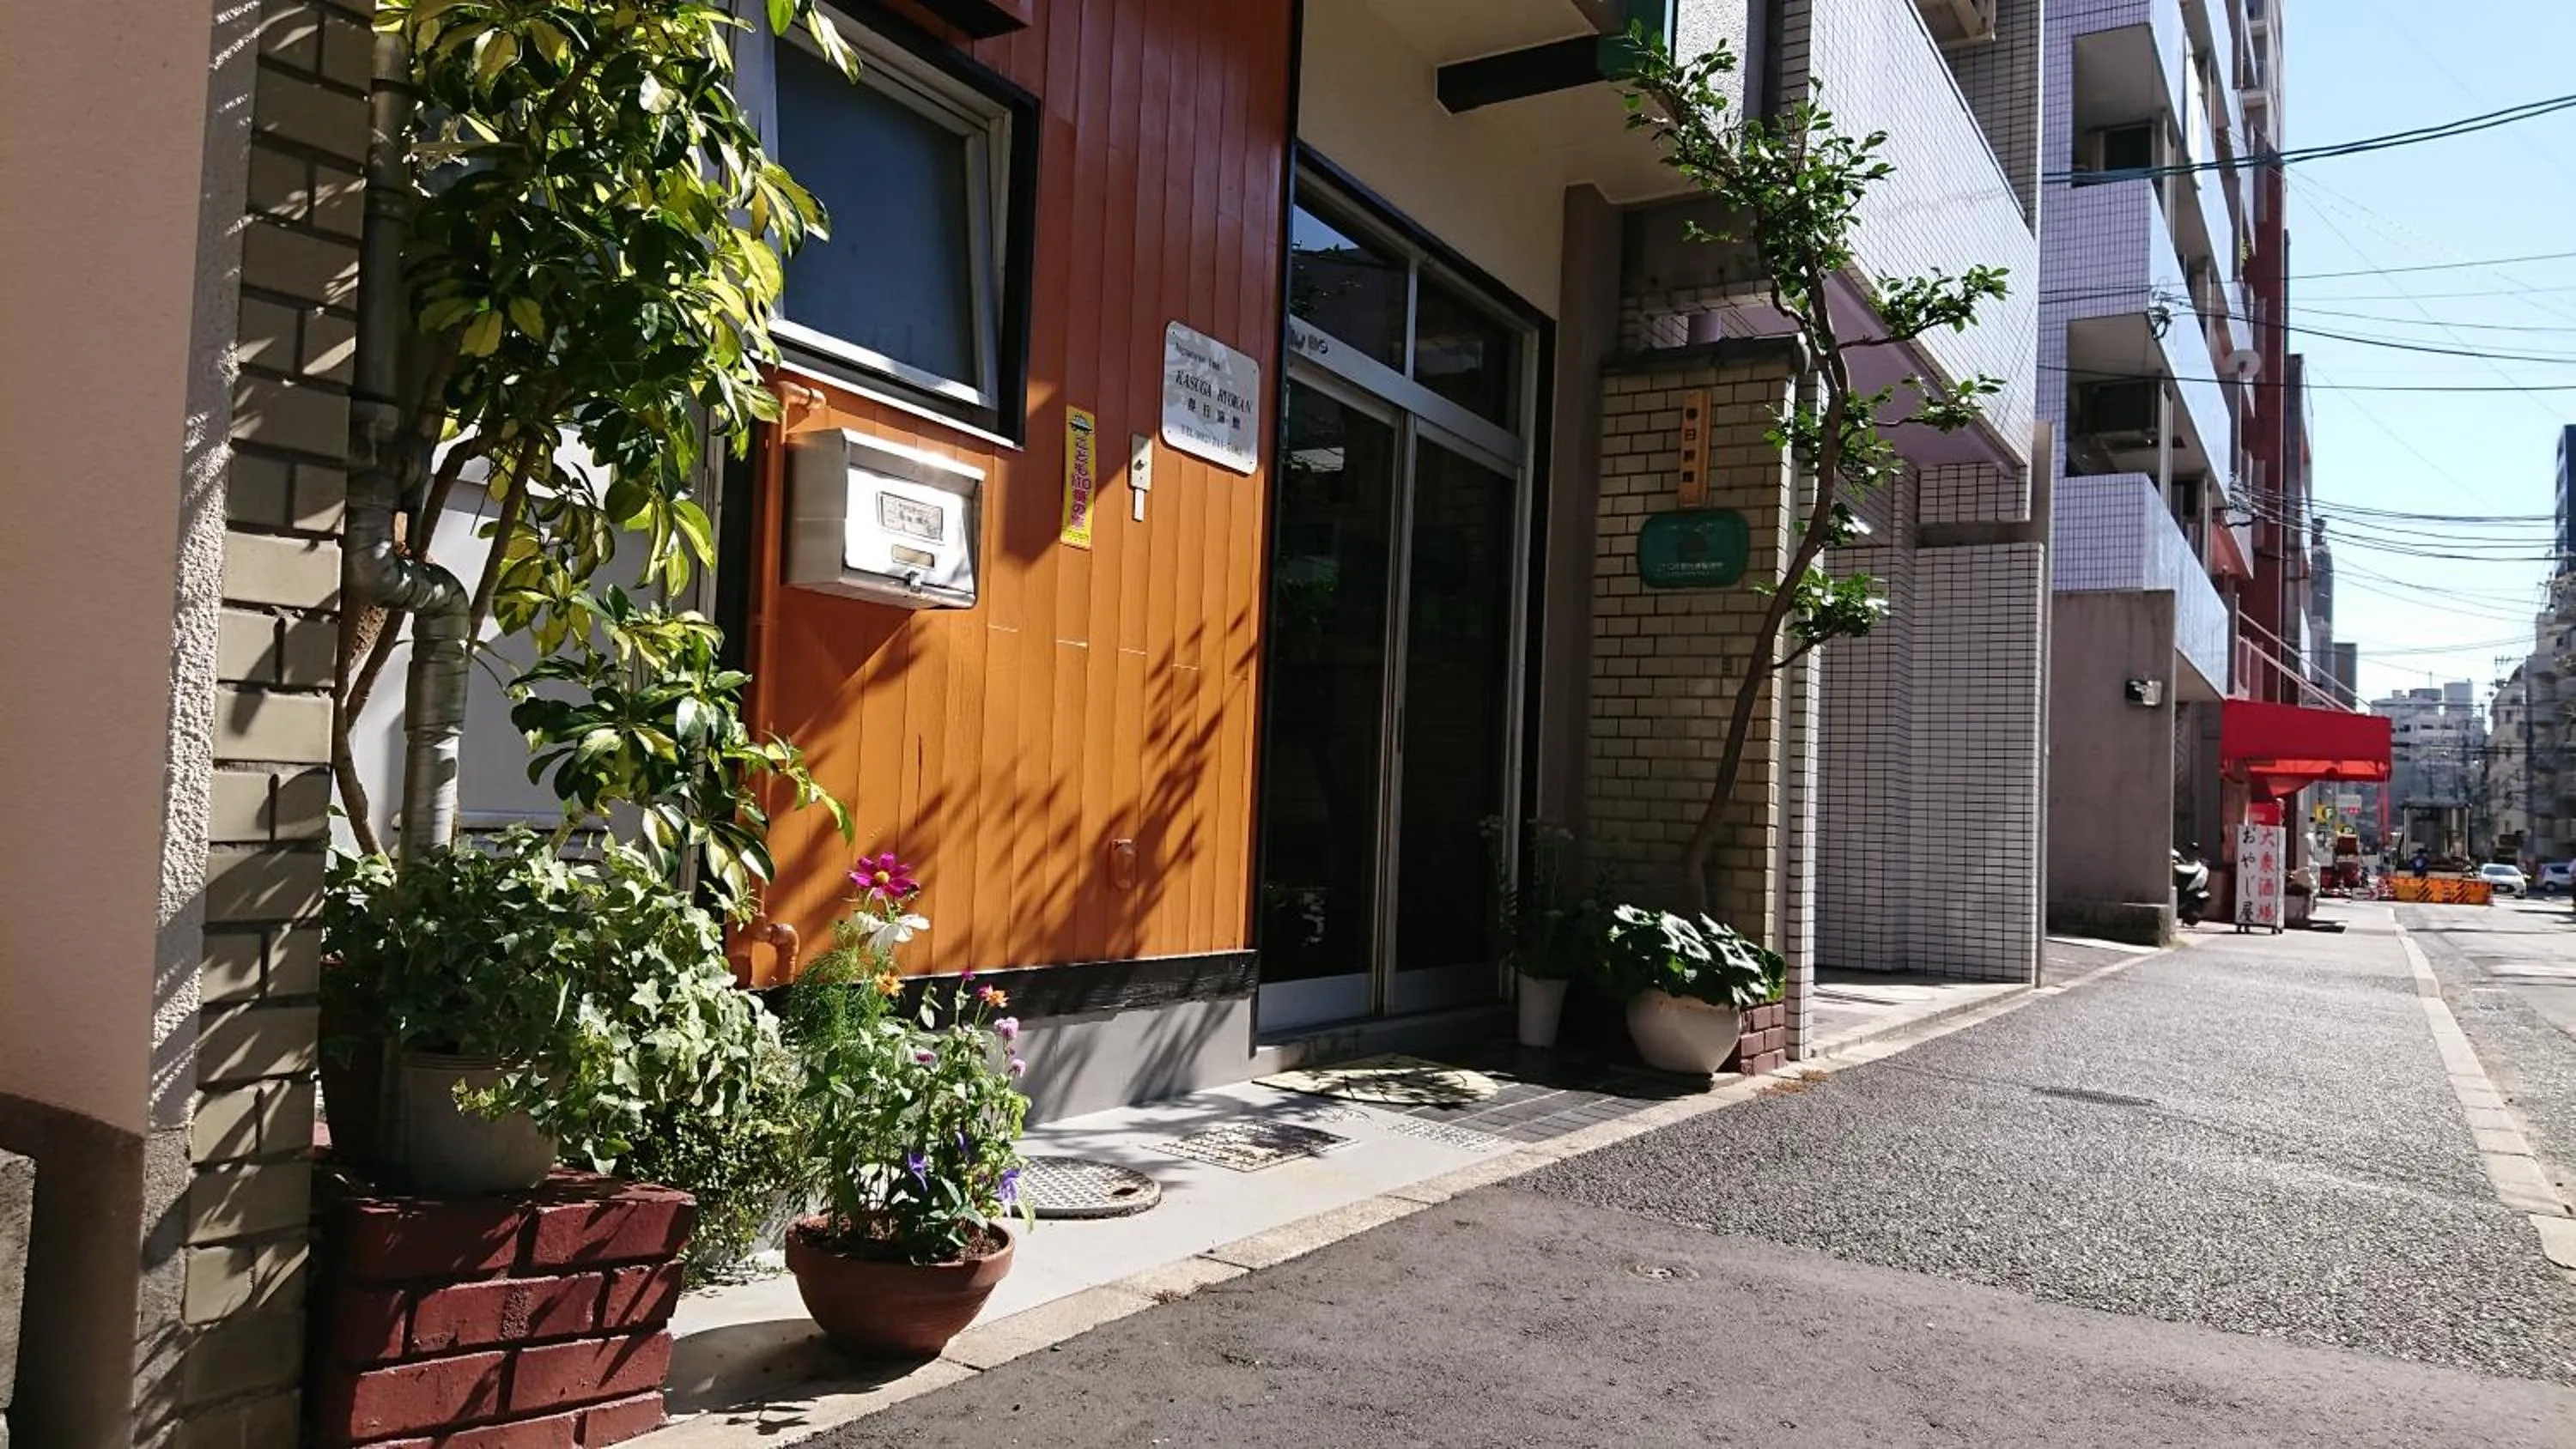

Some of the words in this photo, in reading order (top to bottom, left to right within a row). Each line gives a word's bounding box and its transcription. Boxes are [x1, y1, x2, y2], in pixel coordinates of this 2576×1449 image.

[1176, 370, 1212, 399] KASUGA
[1217, 387, 1252, 415] RYOKAN
[2240, 828, 2256, 923] おやじ屋
[2258, 828, 2275, 922] 大衆酒場
